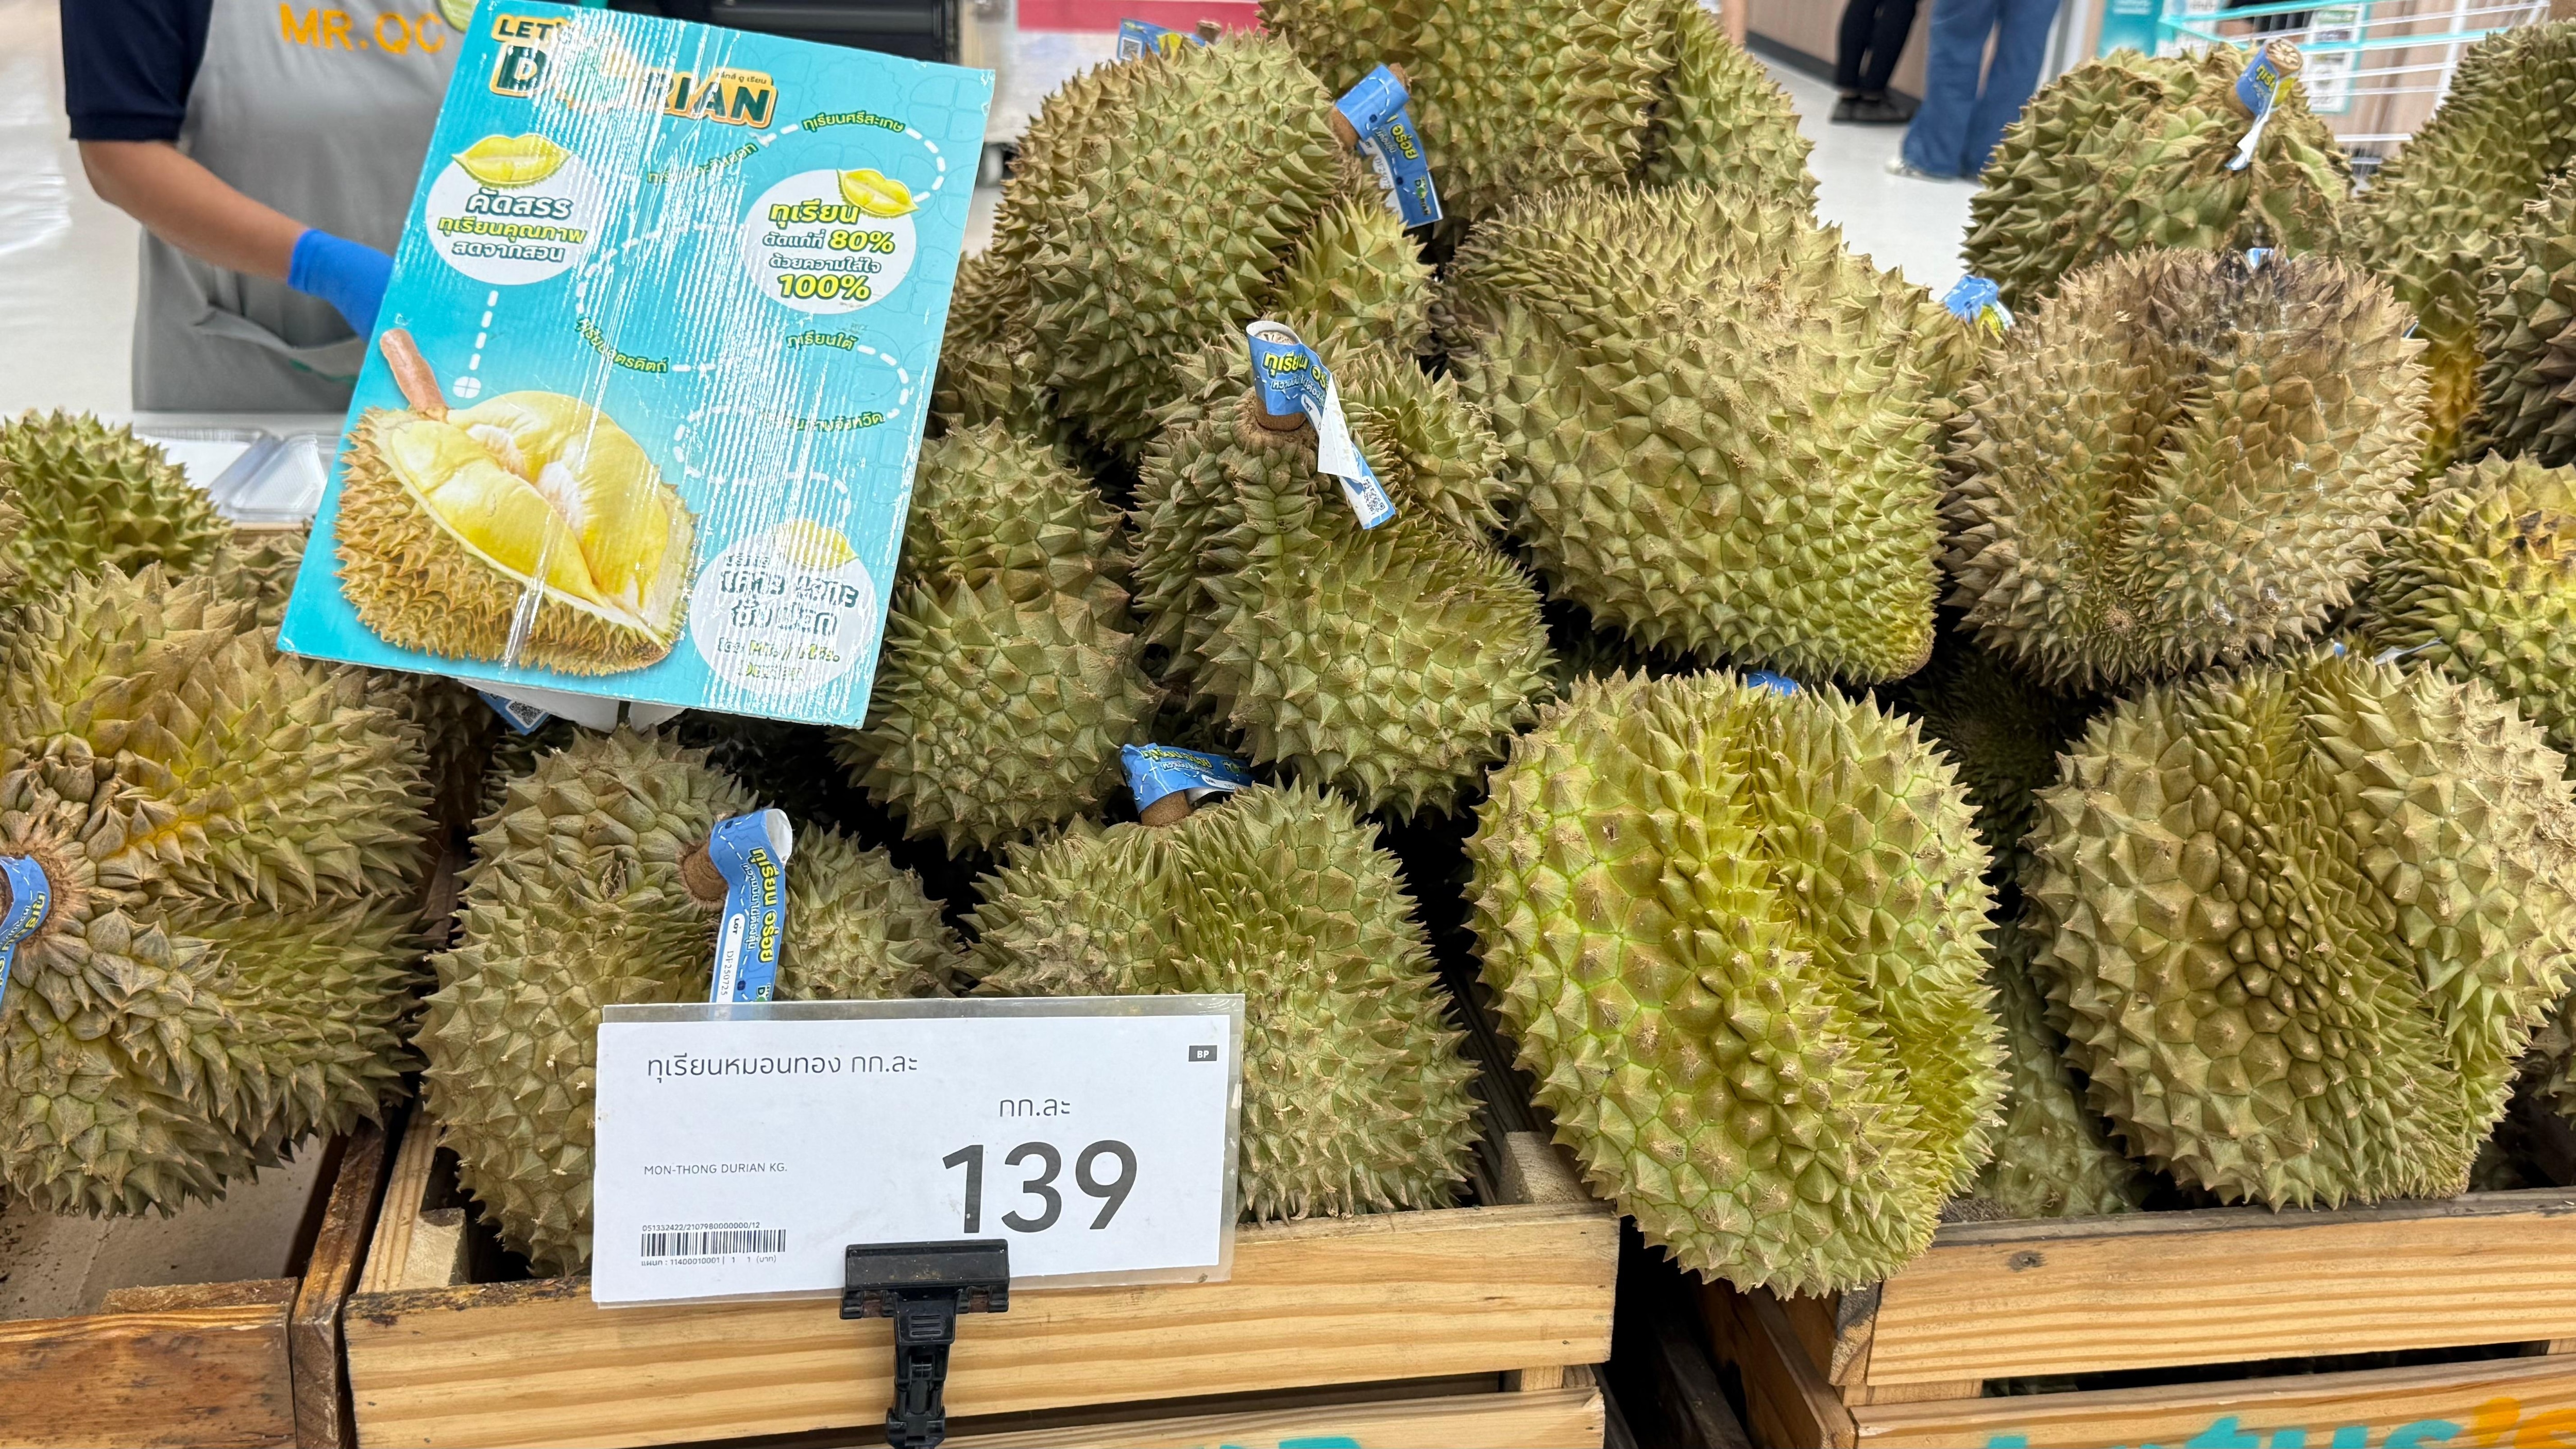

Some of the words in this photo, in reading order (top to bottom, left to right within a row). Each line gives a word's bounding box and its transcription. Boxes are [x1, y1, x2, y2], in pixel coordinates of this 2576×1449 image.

[498, 19, 571, 40] LET'
[802, 110, 906, 133] ทุเรียนศรีสะเกษ
[1391, 123, 1419, 161] อร่อย
[1374, 157, 1392, 189] DF25072
[466, 187, 573, 220] คัดสรร
[768, 198, 861, 230] ทุเรียน
[437, 216, 587, 244] ทุเรียนคุณภาพ
[762, 229, 826, 249] ตัดแก่ที่
[828, 230, 895, 253] 80%
[452, 241, 566, 263] สดจากสวน
[769, 252, 882, 274] ด้วยความใส่ใจ
[777, 274, 872, 300] 100%
[1263, 351, 1310, 379] ทุเรียน
[748, 847, 780, 907] ทุเรียน
[758, 910, 780, 963] อร่อย
[720, 950, 735, 996] DF250725
[648, 1052, 841, 1083] ทุเรียนหมอนทอง
[851, 1055, 918, 1073] กก.ละ
[1196, 1050, 1210, 1059] BP
[999, 1098, 1071, 1117] กก.ละ
[644, 1164, 717, 1175] MON-THONG
[721, 1163, 766, 1173] DURIAN
[769, 1162, 788, 1172] KG.
[942, 1140, 1138, 1233] 139
